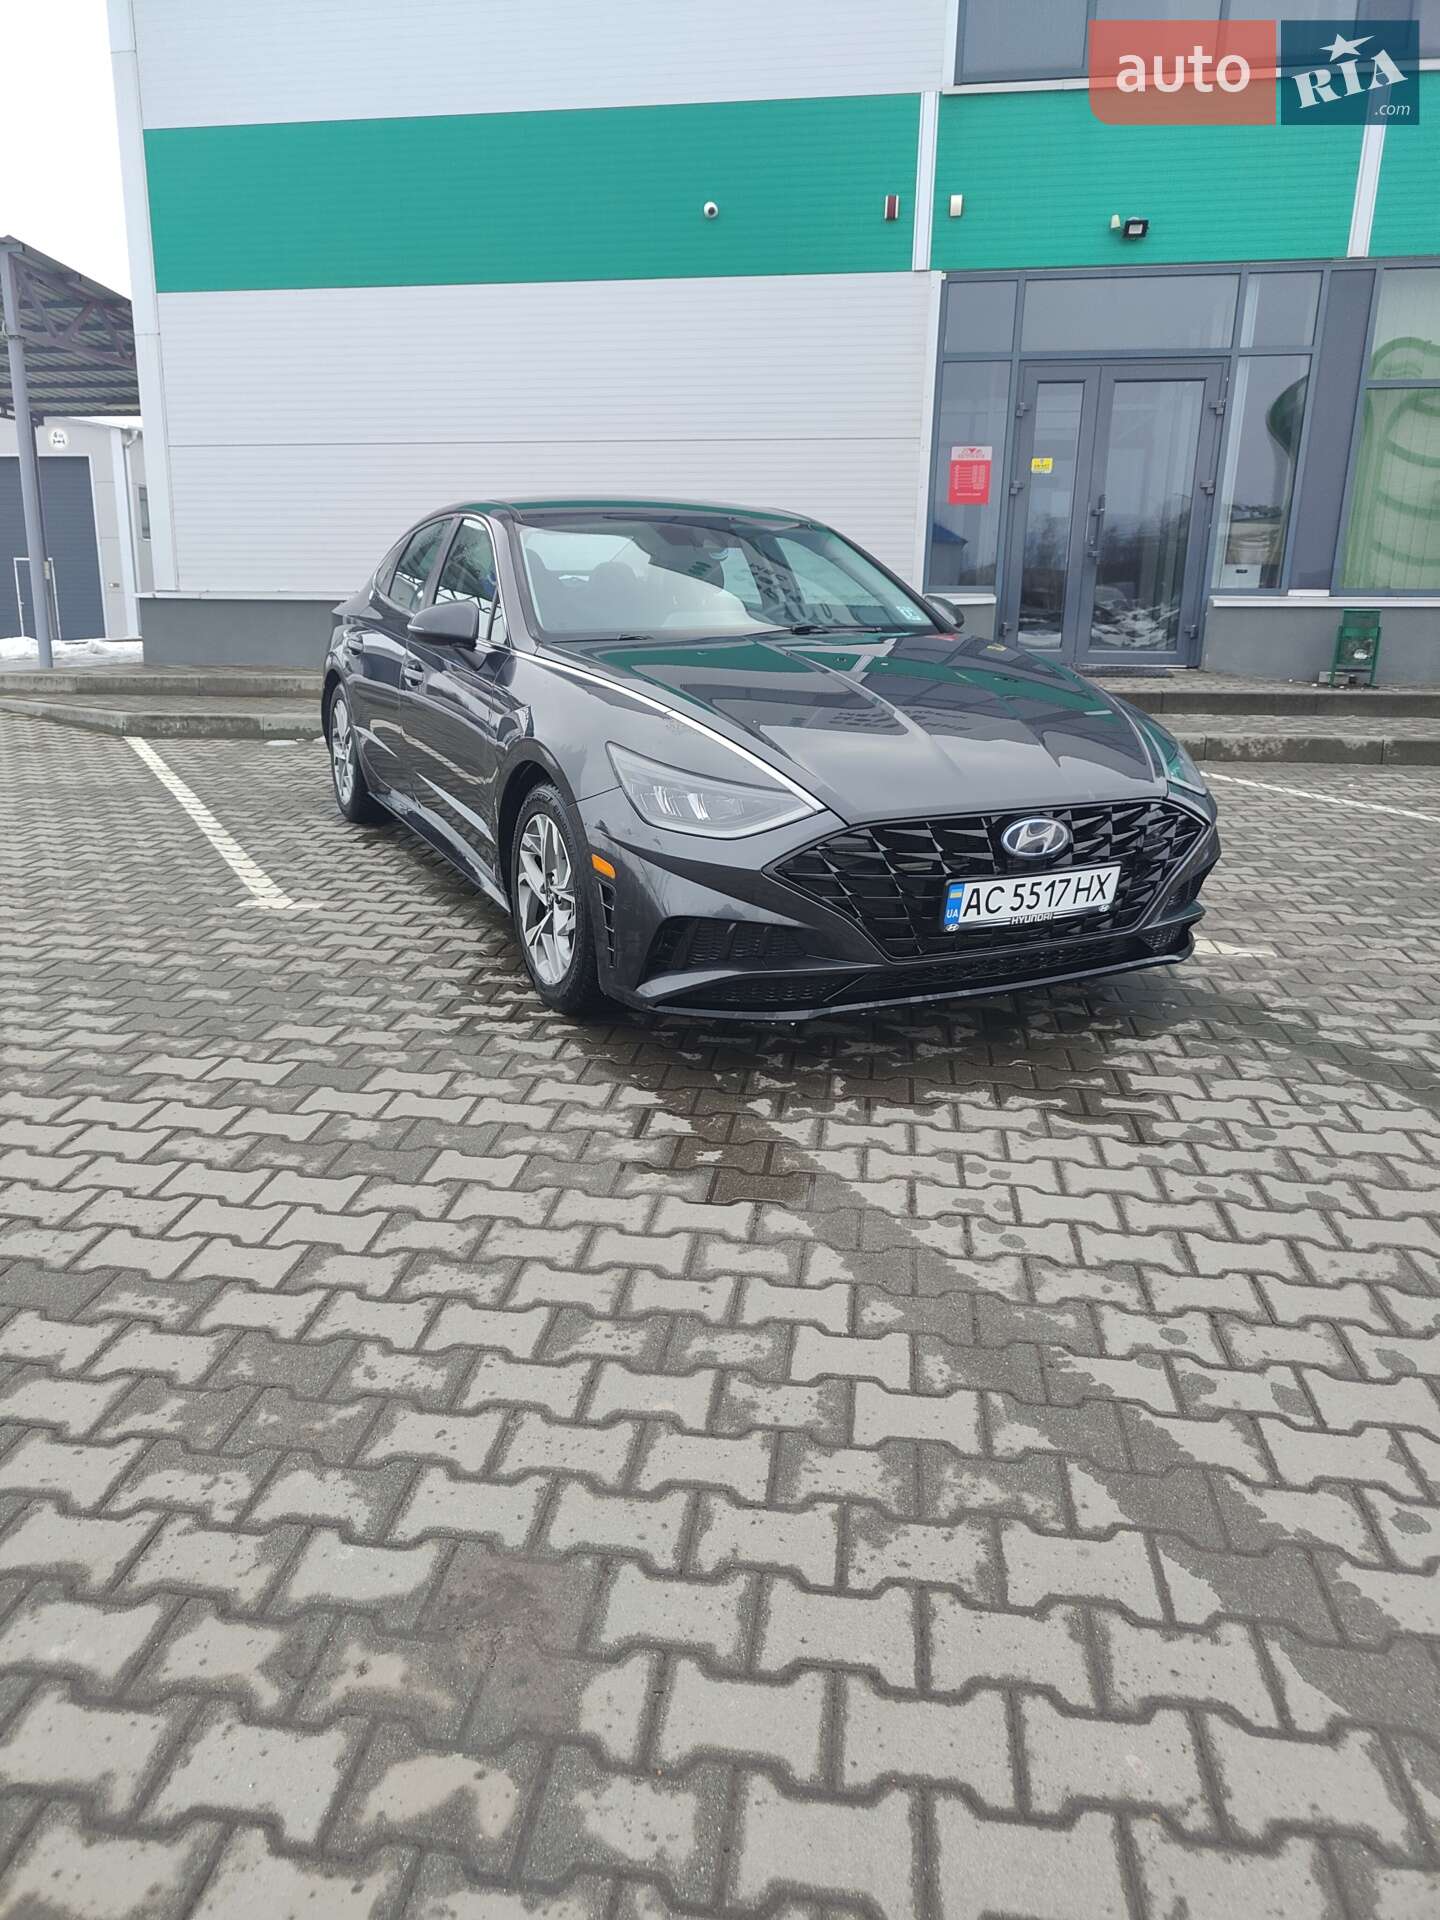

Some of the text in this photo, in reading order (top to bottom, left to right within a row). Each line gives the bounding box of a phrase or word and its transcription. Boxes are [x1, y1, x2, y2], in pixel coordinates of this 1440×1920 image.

[963, 872, 1112, 918] AC 5517 HX
[946, 909, 958, 919] UA
[1011, 912, 1053, 925] HYUNDAI
